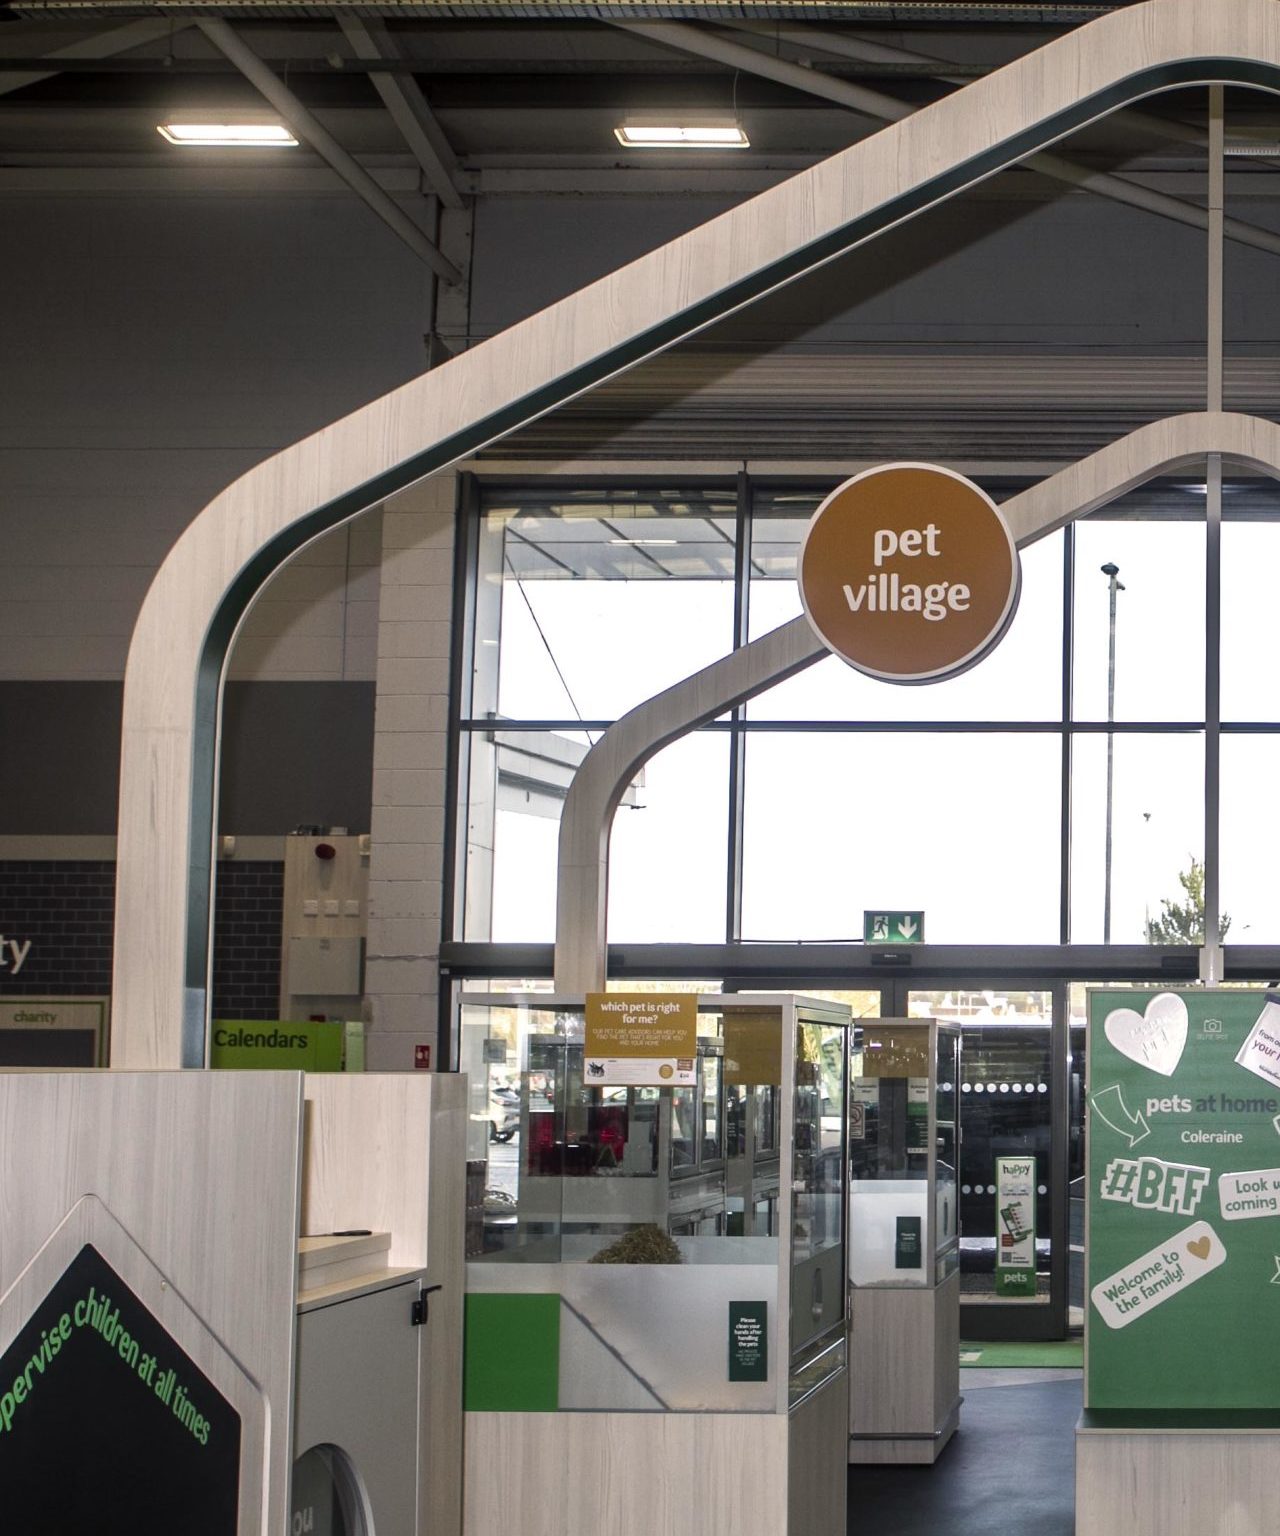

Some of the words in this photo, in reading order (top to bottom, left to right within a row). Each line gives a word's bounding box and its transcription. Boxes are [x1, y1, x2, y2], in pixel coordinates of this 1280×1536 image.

[873, 523, 941, 567] pet
[842, 572, 971, 621] village
[600, 1001, 628, 1012] which
[629, 1002, 645, 1014] pet
[647, 1002, 656, 1012] is
[656, 1002, 680, 1014] right
[13, 1010, 57, 1025] charity
[622, 1014, 637, 1024] for
[638, 1014, 658, 1024] me?
[213, 1028, 309, 1048] Calendars
[1258, 1029, 1275, 1043] from
[1252, 1039, 1277, 1057] your
[1146, 1094, 1192, 1117] pets
[1195, 1095, 1217, 1113] at
[1220, 1093, 1278, 1113] home
[1180, 1130, 1243, 1144] Coleraine
[1104, 1159, 1208, 1212] #BFF
[1235, 1177, 1268, 1195] Look
[1225, 1196, 1278, 1212] coming
[1003, 1272, 1028, 1283] pets
[1102, 1261, 1163, 1302] Welcome
[1161, 1251, 1180, 1265] to
[1115, 1295, 1141, 1314] the
[1139, 1263, 1185, 1300] family!
[74, 1286, 140, 1369] children
[137, 1352, 158, 1387] at
[154, 1368, 177, 1406] all
[172, 1384, 211, 1446] times
